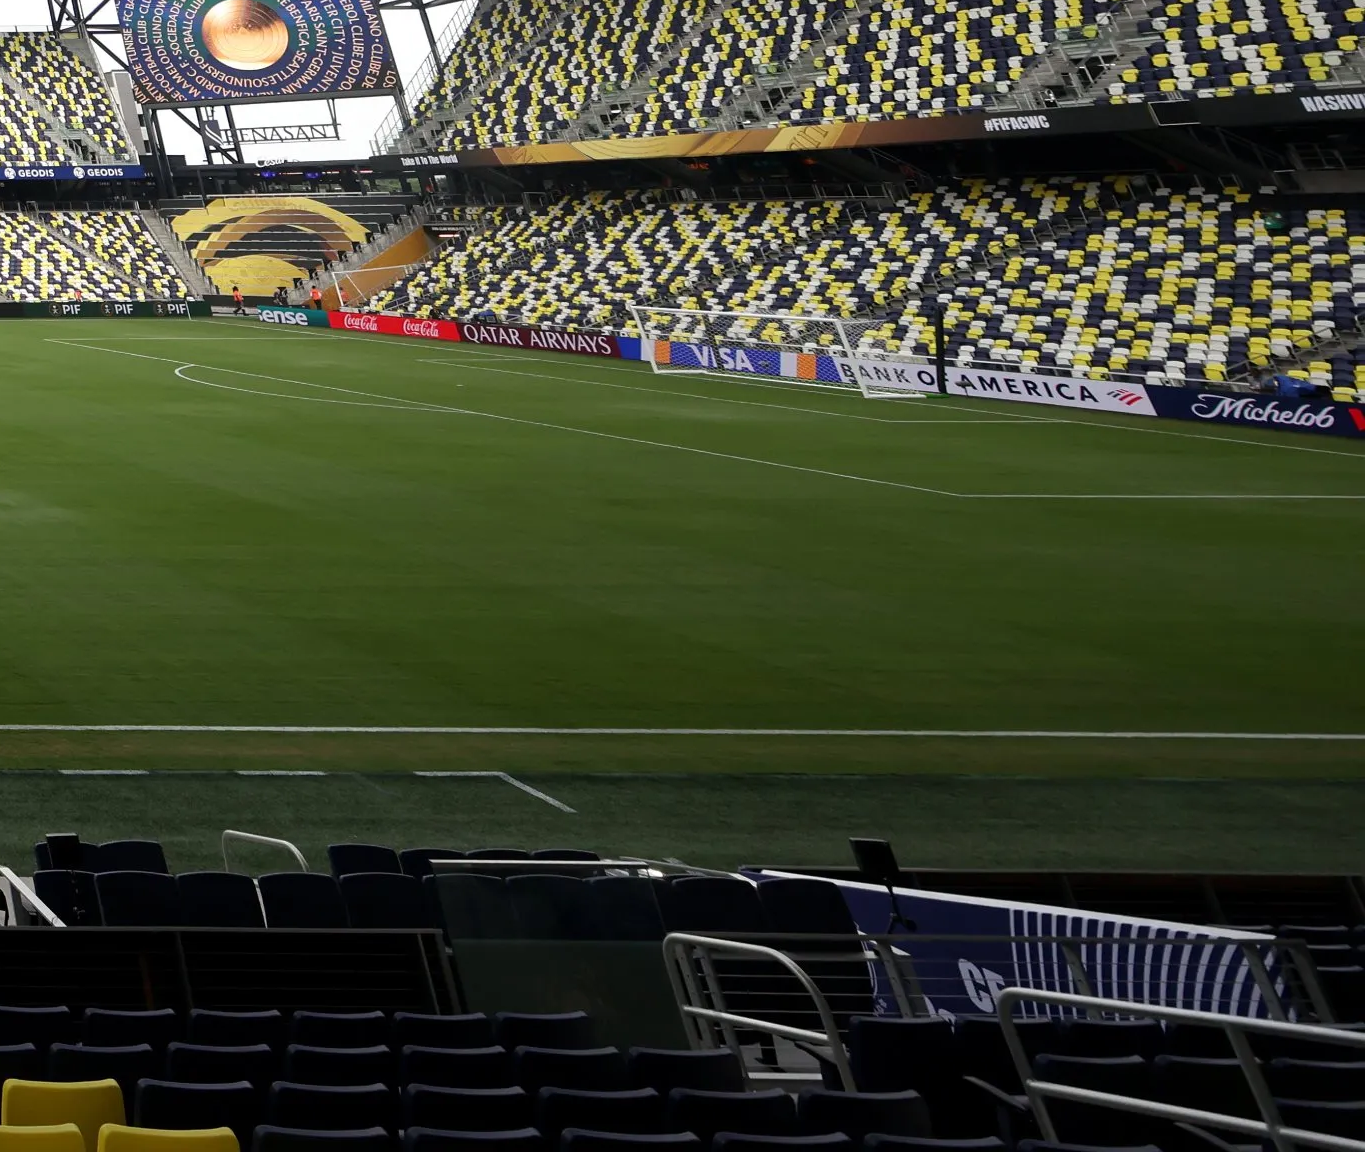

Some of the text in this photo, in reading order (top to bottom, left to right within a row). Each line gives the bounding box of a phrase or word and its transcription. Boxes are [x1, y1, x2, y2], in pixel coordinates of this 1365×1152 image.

[123, 10, 133, 22] FC
[167, 0, 183, 56] SOCIEDADE
[285, 3, 309, 47] BENFICA
[123, 28, 139, 63] TUNISIE
[183, 18, 206, 70] FOOTBALL
[331, 18, 346, 45] CITY
[351, 25, 364, 58] CLUBE
[132, 63, 146, 78] DE
[137, 20, 175, 94] FOOTBALL CLUB
[270, 50, 307, 86] SEATTLE
[283, 22, 327, 94] SAINT-GERMAIN
[348, 58, 363, 76] DO
[361, 44, 384, 89] CLUBE DE
[155, 46, 201, 98] MAMELODI
[205, 66, 270, 88] SOUNDERS
[984, 114, 1050, 132] #FIFACWC
[18, 168, 55, 178] GEODIS
[87, 168, 124, 177] GEODIS
[401, 156, 415, 166] Take
[420, 156, 428, 165] To
[427, 155, 439, 164] The
[439, 154, 458, 164] World
[62, 303, 81, 315] PIF
[115, 303, 134, 315] PIF
[167, 303, 186, 315] PIF
[344, 313, 378, 332] Coca-Cola
[403, 319, 439, 338] Coca-Cola
[463, 323, 611, 355] QATAR AIRWAYS
[689, 344, 756, 374] VISA
[840, 362, 911, 384] BANK
[957, 373, 1100, 403] AMERICA
[1191, 393, 1335, 428] Michelob
